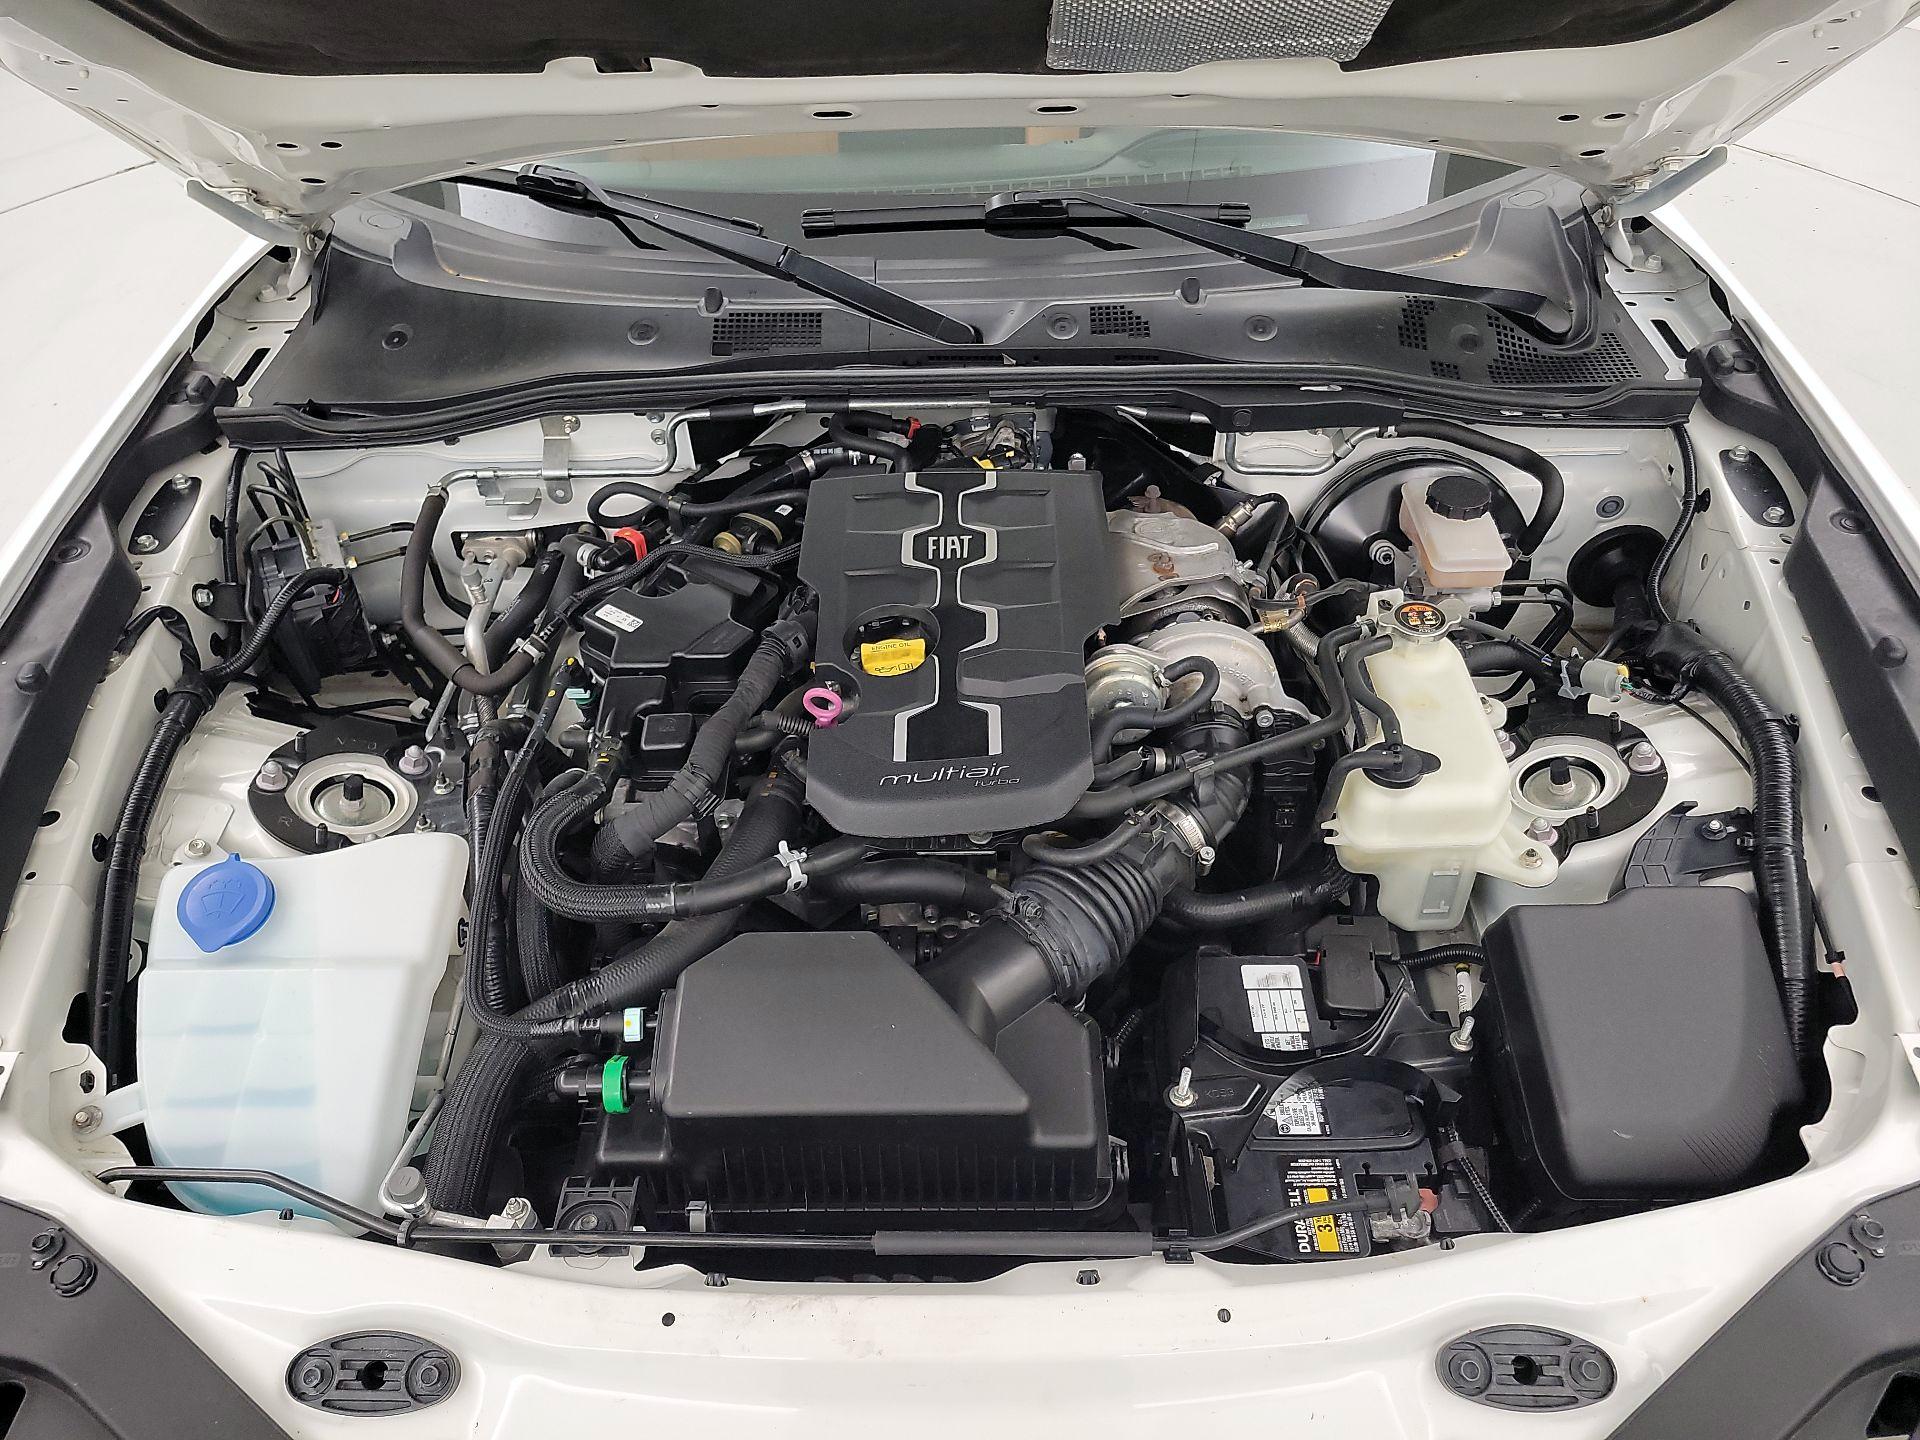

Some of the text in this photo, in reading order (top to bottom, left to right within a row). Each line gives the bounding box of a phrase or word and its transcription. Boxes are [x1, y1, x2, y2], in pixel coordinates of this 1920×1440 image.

[928, 535, 973, 560] FIAT
[871, 643, 897, 651] ENGINE
[879, 763, 1010, 786] multiair
[975, 778, 1020, 787] turbo
[1288, 1188, 1312, 1253] DURAELL
[1317, 1223, 1333, 1233] 3
